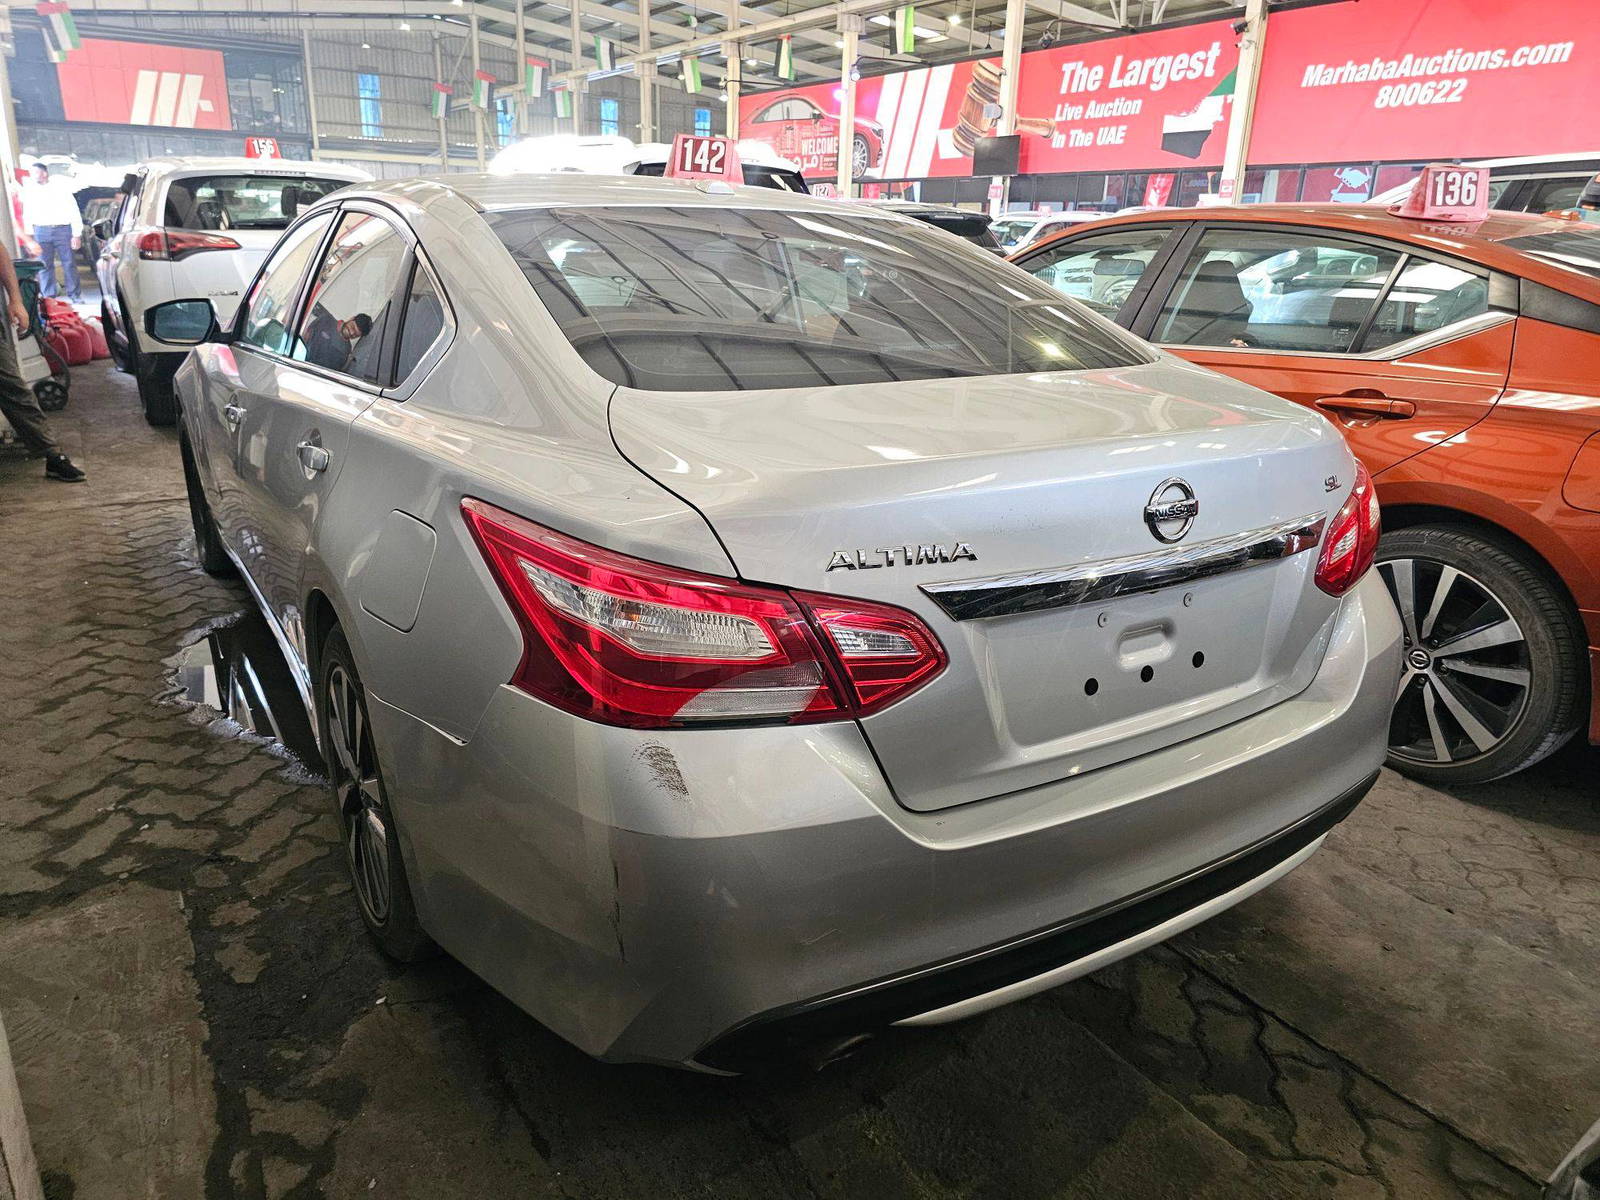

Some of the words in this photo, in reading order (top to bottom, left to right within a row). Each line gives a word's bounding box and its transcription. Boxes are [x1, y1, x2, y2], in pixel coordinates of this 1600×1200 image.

[1060, 61, 1103, 94] The
[1109, 42, 1220, 91] Largest
[1301, 42, 1574, 87] MarhabaAuctions.com
[1374, 78, 1467, 108] 800622
[1055, 103, 1083, 121] Live
[1085, 97, 1142, 119] Auction
[801, 136, 839, 156] WELCOME
[1052, 131, 1065, 148] In
[1068, 129, 1093, 147] The
[1097, 125, 1127, 145] UAE
[683, 139, 726, 173] 142
[1435, 171, 1478, 206] 136
[1324, 474, 1342, 493] SL
[825, 542, 978, 572] ALTIMA
